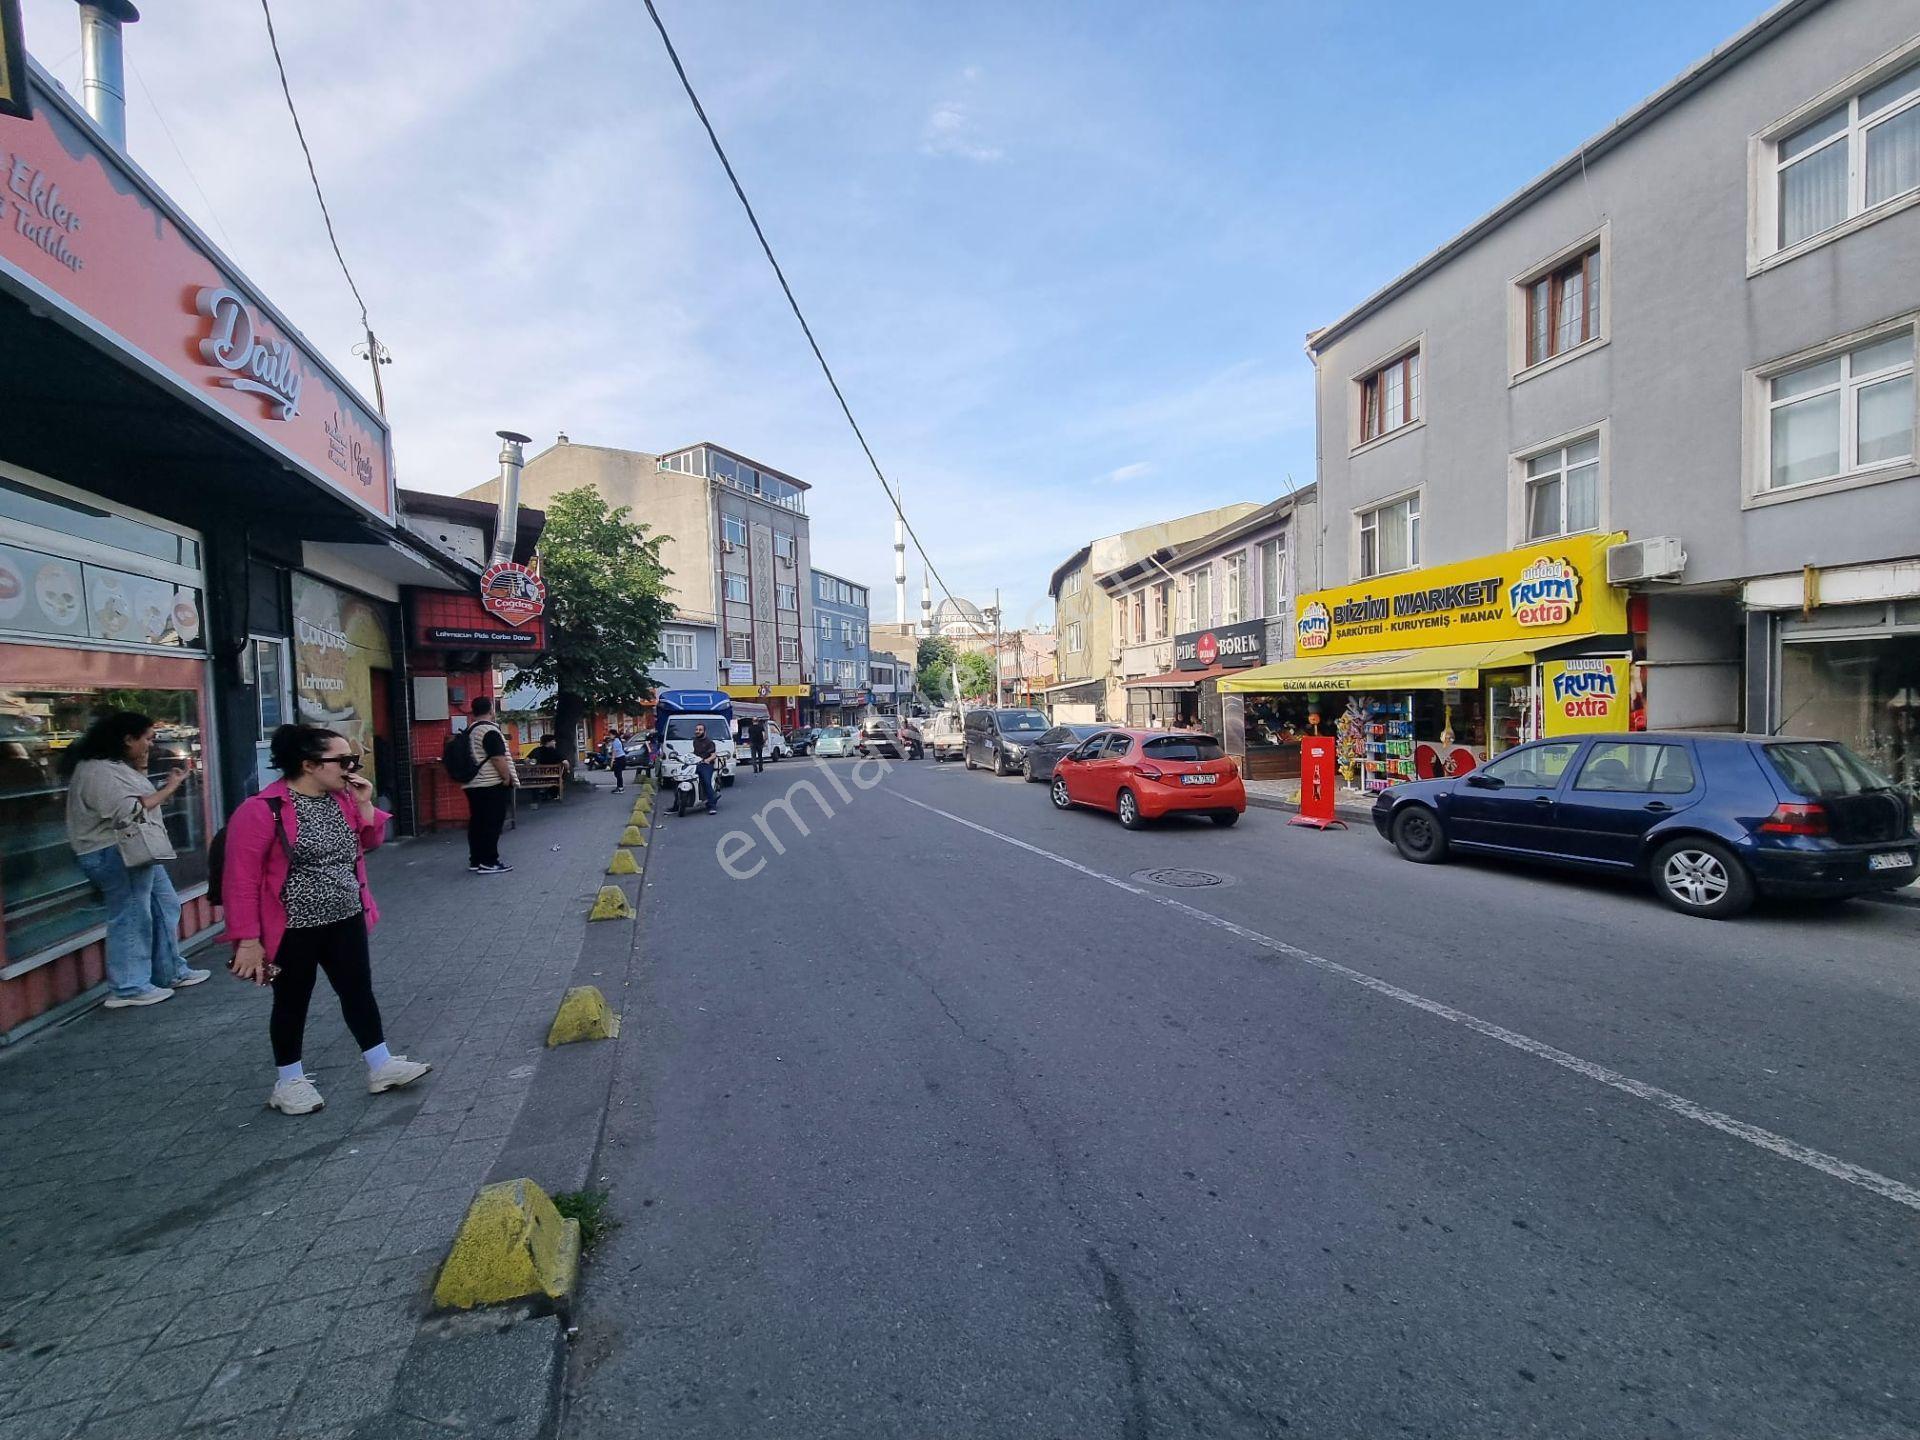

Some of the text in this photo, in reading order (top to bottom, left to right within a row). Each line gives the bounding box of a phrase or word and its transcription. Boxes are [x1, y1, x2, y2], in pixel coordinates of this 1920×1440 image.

[8, 153, 81, 233] Ekler
[204, 288, 302, 421] Daily
[1333, 578, 1502, 625] BİZİM MARKET
[1391, 614, 1450, 632] KURUYEMİŞ
[1461, 609, 1504, 624] MANAV
[1519, 604, 1563, 623] extra
[1302, 634, 1323, 647] extra
[1283, 679, 1351, 690] BİZİM MARKET
[1565, 698, 1608, 718] extra
